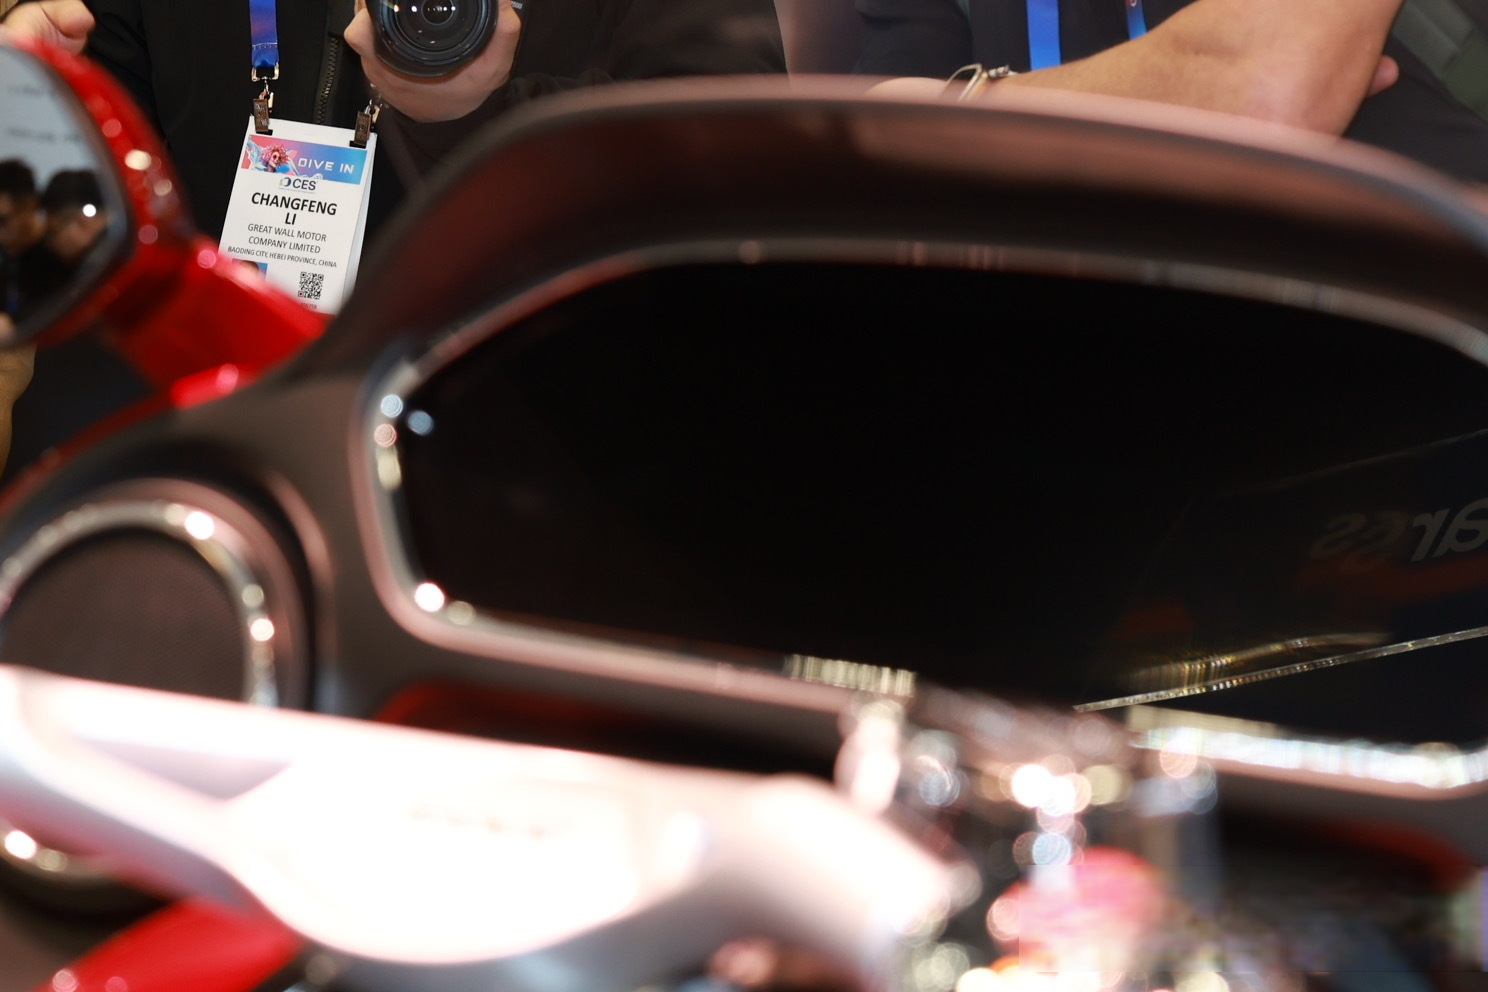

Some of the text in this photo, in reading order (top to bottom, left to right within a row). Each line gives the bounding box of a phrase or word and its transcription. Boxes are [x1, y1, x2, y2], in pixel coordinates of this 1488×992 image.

[298, 157, 354, 174] DIVE IN
[292, 178, 317, 190] CES
[251, 192, 338, 216] CHANGFENG
[284, 212, 297, 226] LI
[247, 223, 327, 242] GREAT WALL MOTOR
[248, 236, 321, 254] COMPANY LIMITED
[227, 246, 255, 256] BAODING
[269, 252, 287, 261] HEBEI
[318, 259, 337, 268] CHINA
